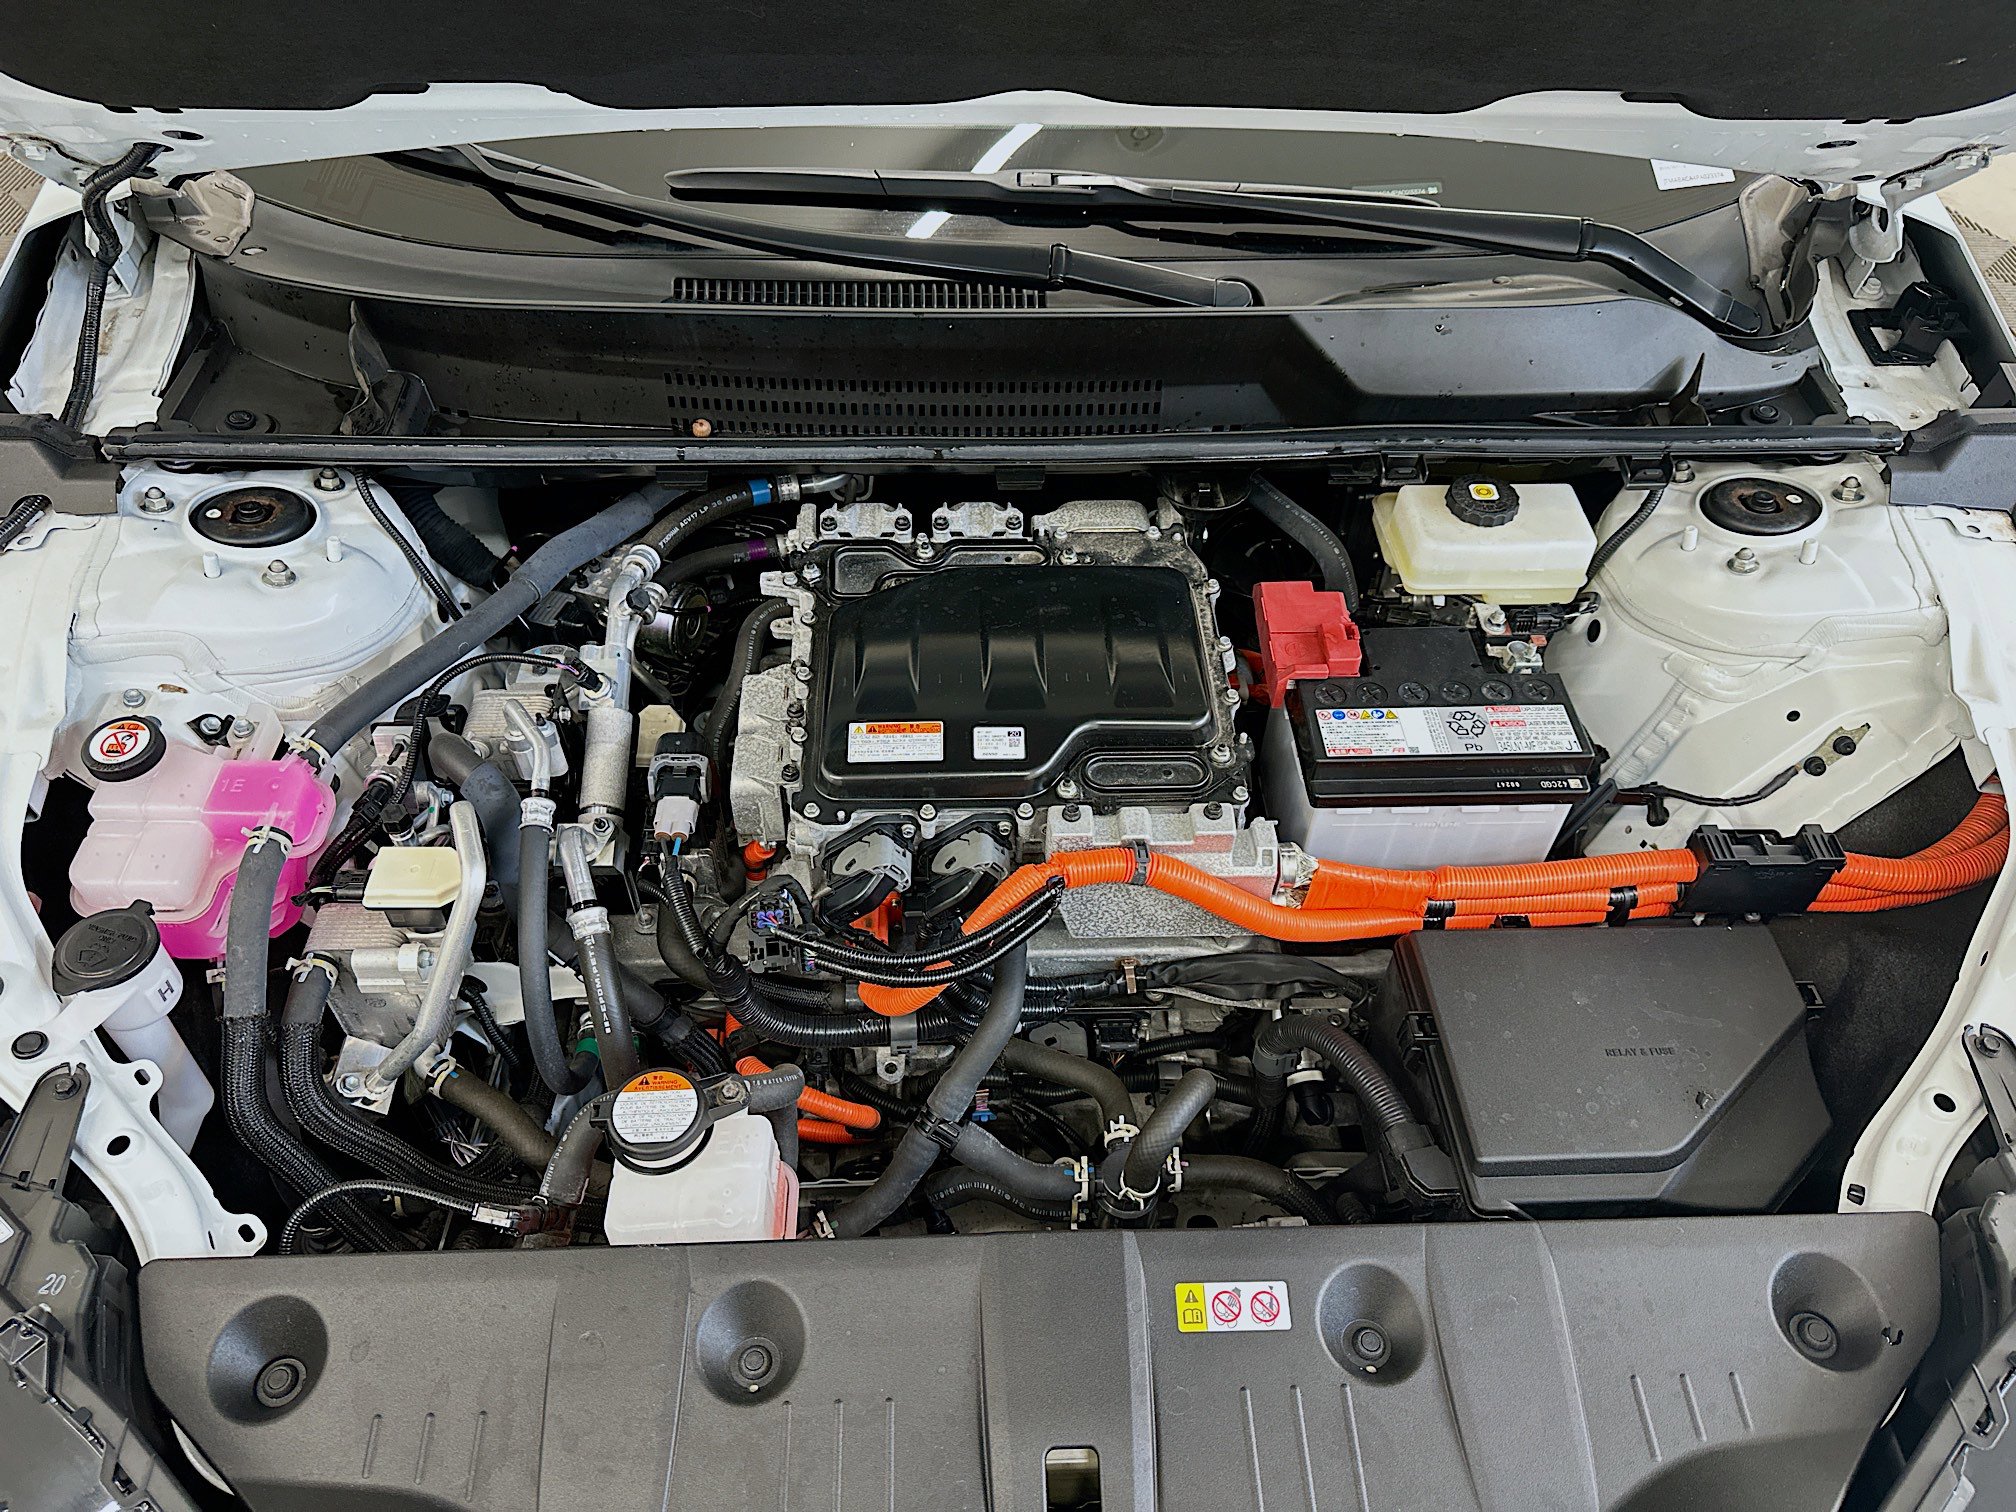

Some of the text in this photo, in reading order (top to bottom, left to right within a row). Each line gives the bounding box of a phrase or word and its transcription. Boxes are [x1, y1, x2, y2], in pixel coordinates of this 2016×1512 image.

[158, 979, 174, 1002] H
[1605, 1047, 1676, 1056] RELAY & FUSE
[38, 1273, 66, 1296] 20
